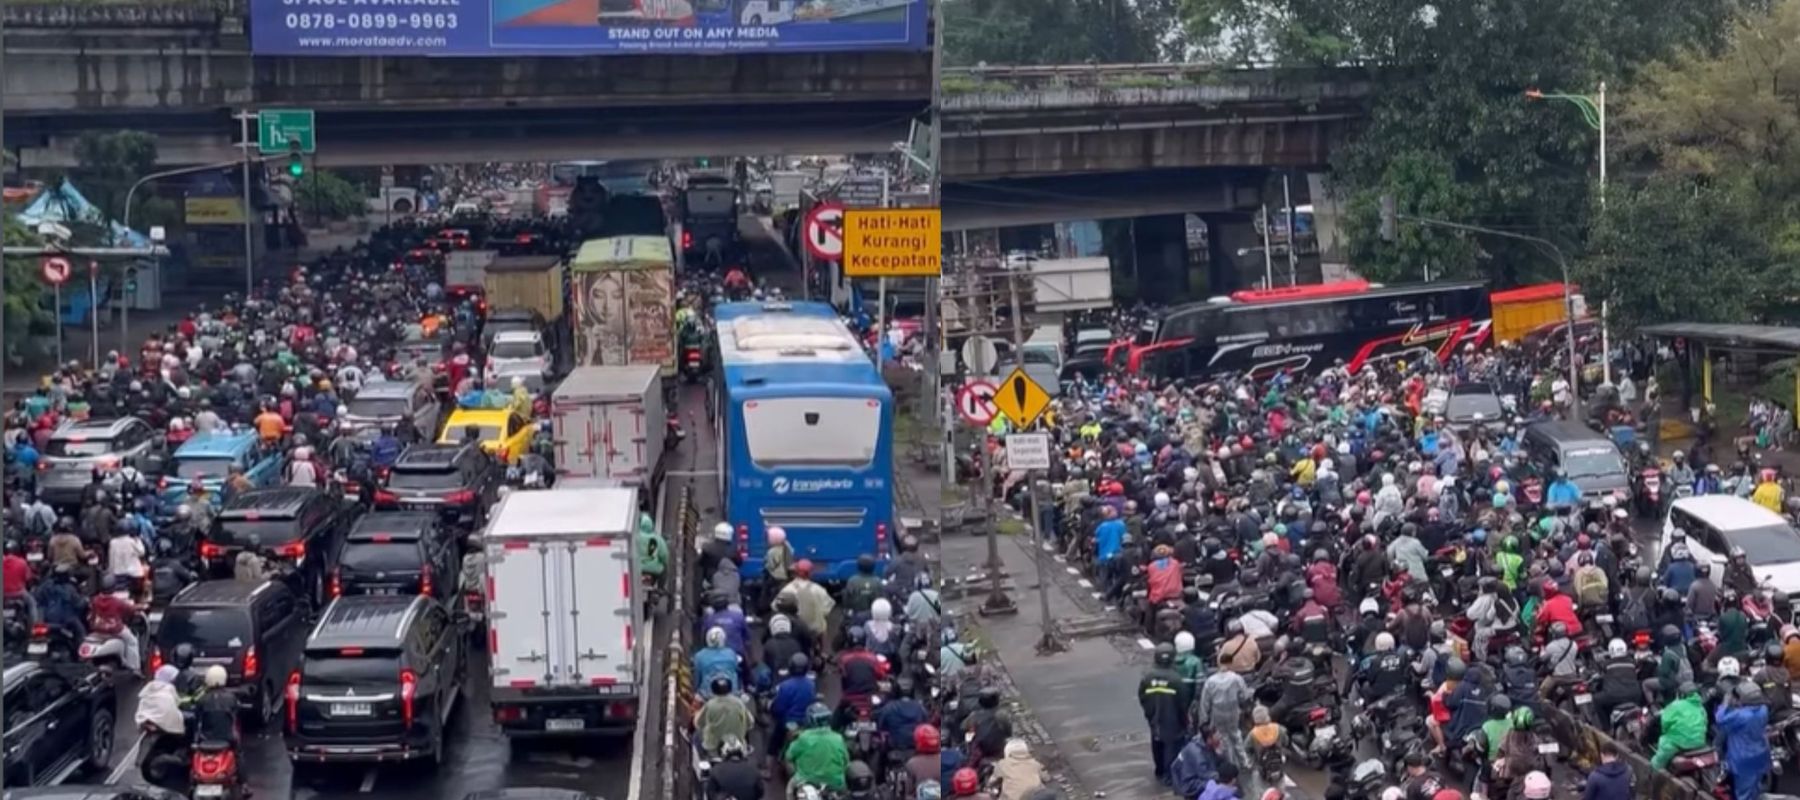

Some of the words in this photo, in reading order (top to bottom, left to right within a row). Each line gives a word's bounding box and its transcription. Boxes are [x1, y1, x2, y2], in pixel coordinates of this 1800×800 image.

[286, 13, 458, 29] 0878-0899-9963
[608, 28, 651, 40] STAND
[654, 28, 680, 39] OUT
[683, 28, 703, 39] ON
[706, 27, 735, 39] ANY
[737, 26, 779, 39] MEDIA
[859, 216, 931, 229] Hati-Hati
[863, 236, 926, 251] Kurangi
[853, 255, 937, 269] Kecepatan
